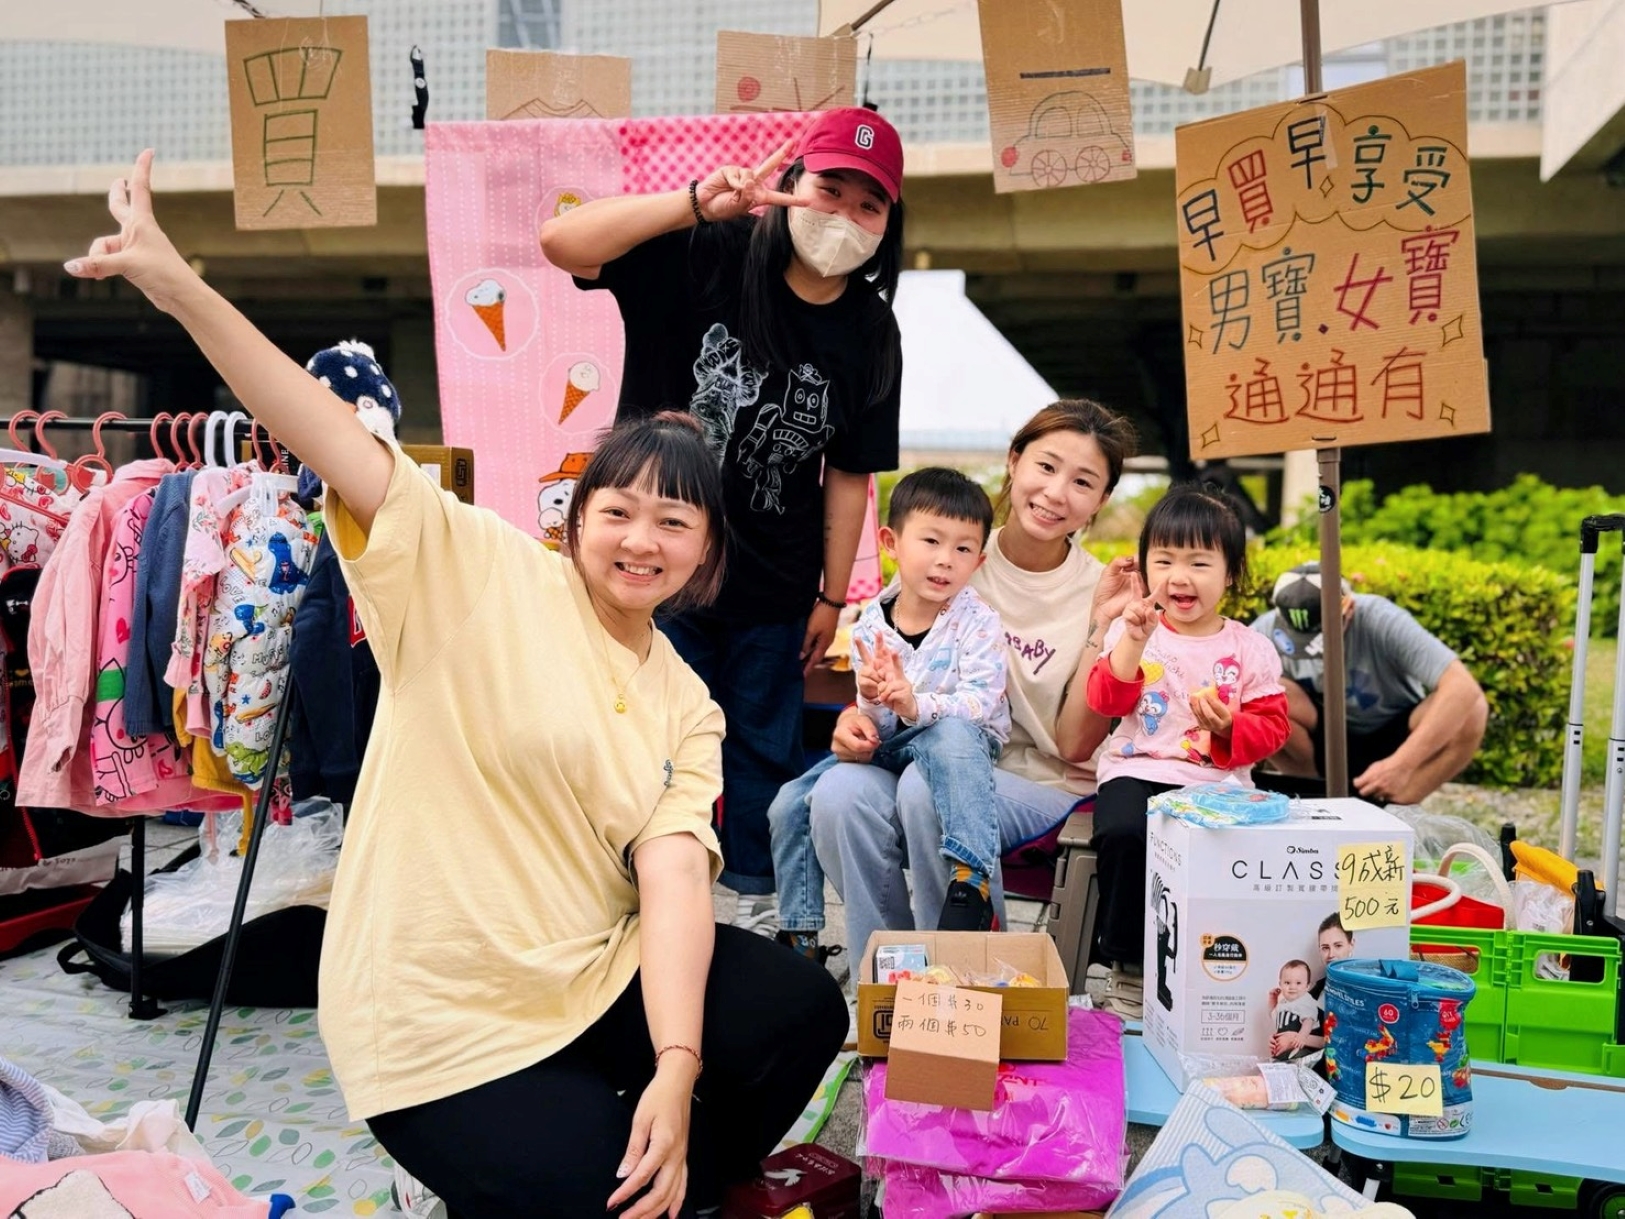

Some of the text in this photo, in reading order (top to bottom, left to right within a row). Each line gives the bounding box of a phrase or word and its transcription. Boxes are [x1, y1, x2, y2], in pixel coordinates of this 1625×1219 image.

[243, 46, 344, 217] 買
[855, 124, 875, 150] G
[1183, 115, 1451, 261] 早買早享受
[1225, 347, 1428, 425] 通通有
[1296, 846, 1319, 854] Simba
[1341, 845, 1406, 885] 9成新
[1344, 896, 1400, 921] 500元
